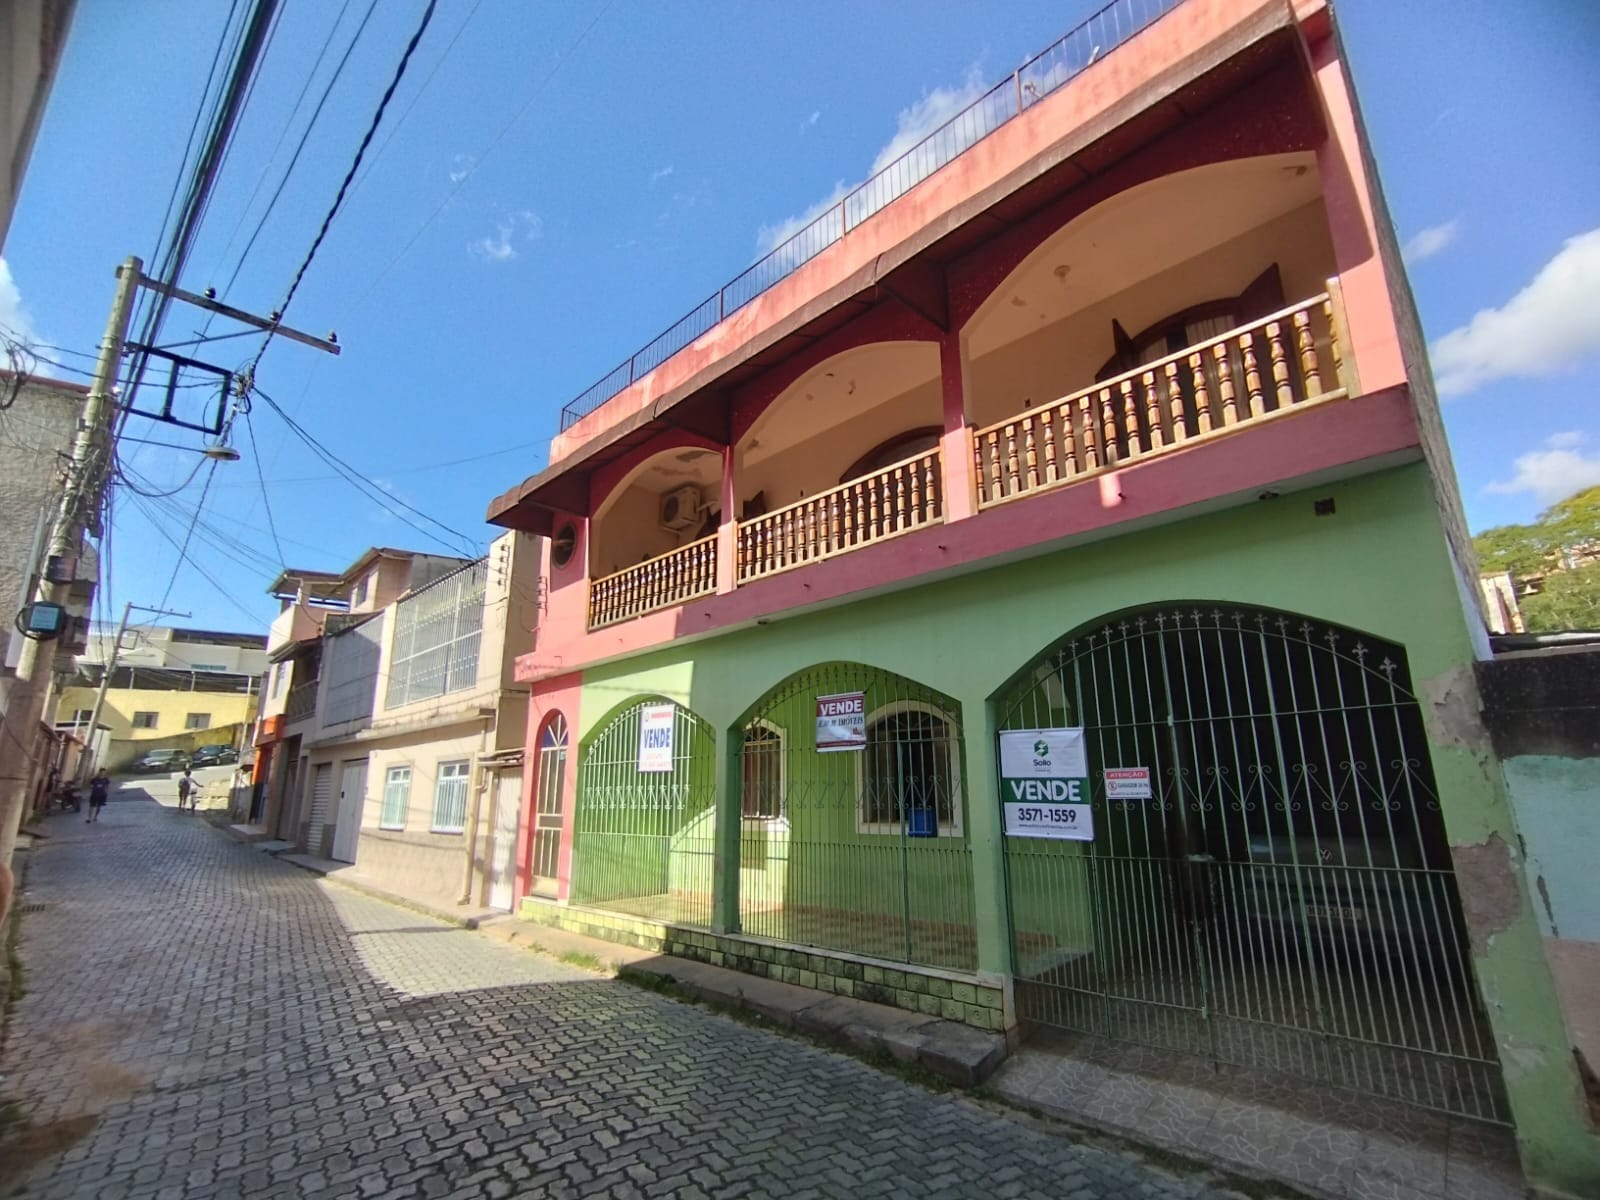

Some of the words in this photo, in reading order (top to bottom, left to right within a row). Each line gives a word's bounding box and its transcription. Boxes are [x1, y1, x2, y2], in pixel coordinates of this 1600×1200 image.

[820, 699, 862, 716] VENDE
[643, 727, 671, 749] VENDE
[1010, 780, 1082, 802] VENDE
[1017, 807, 1077, 823] 3571-1559
